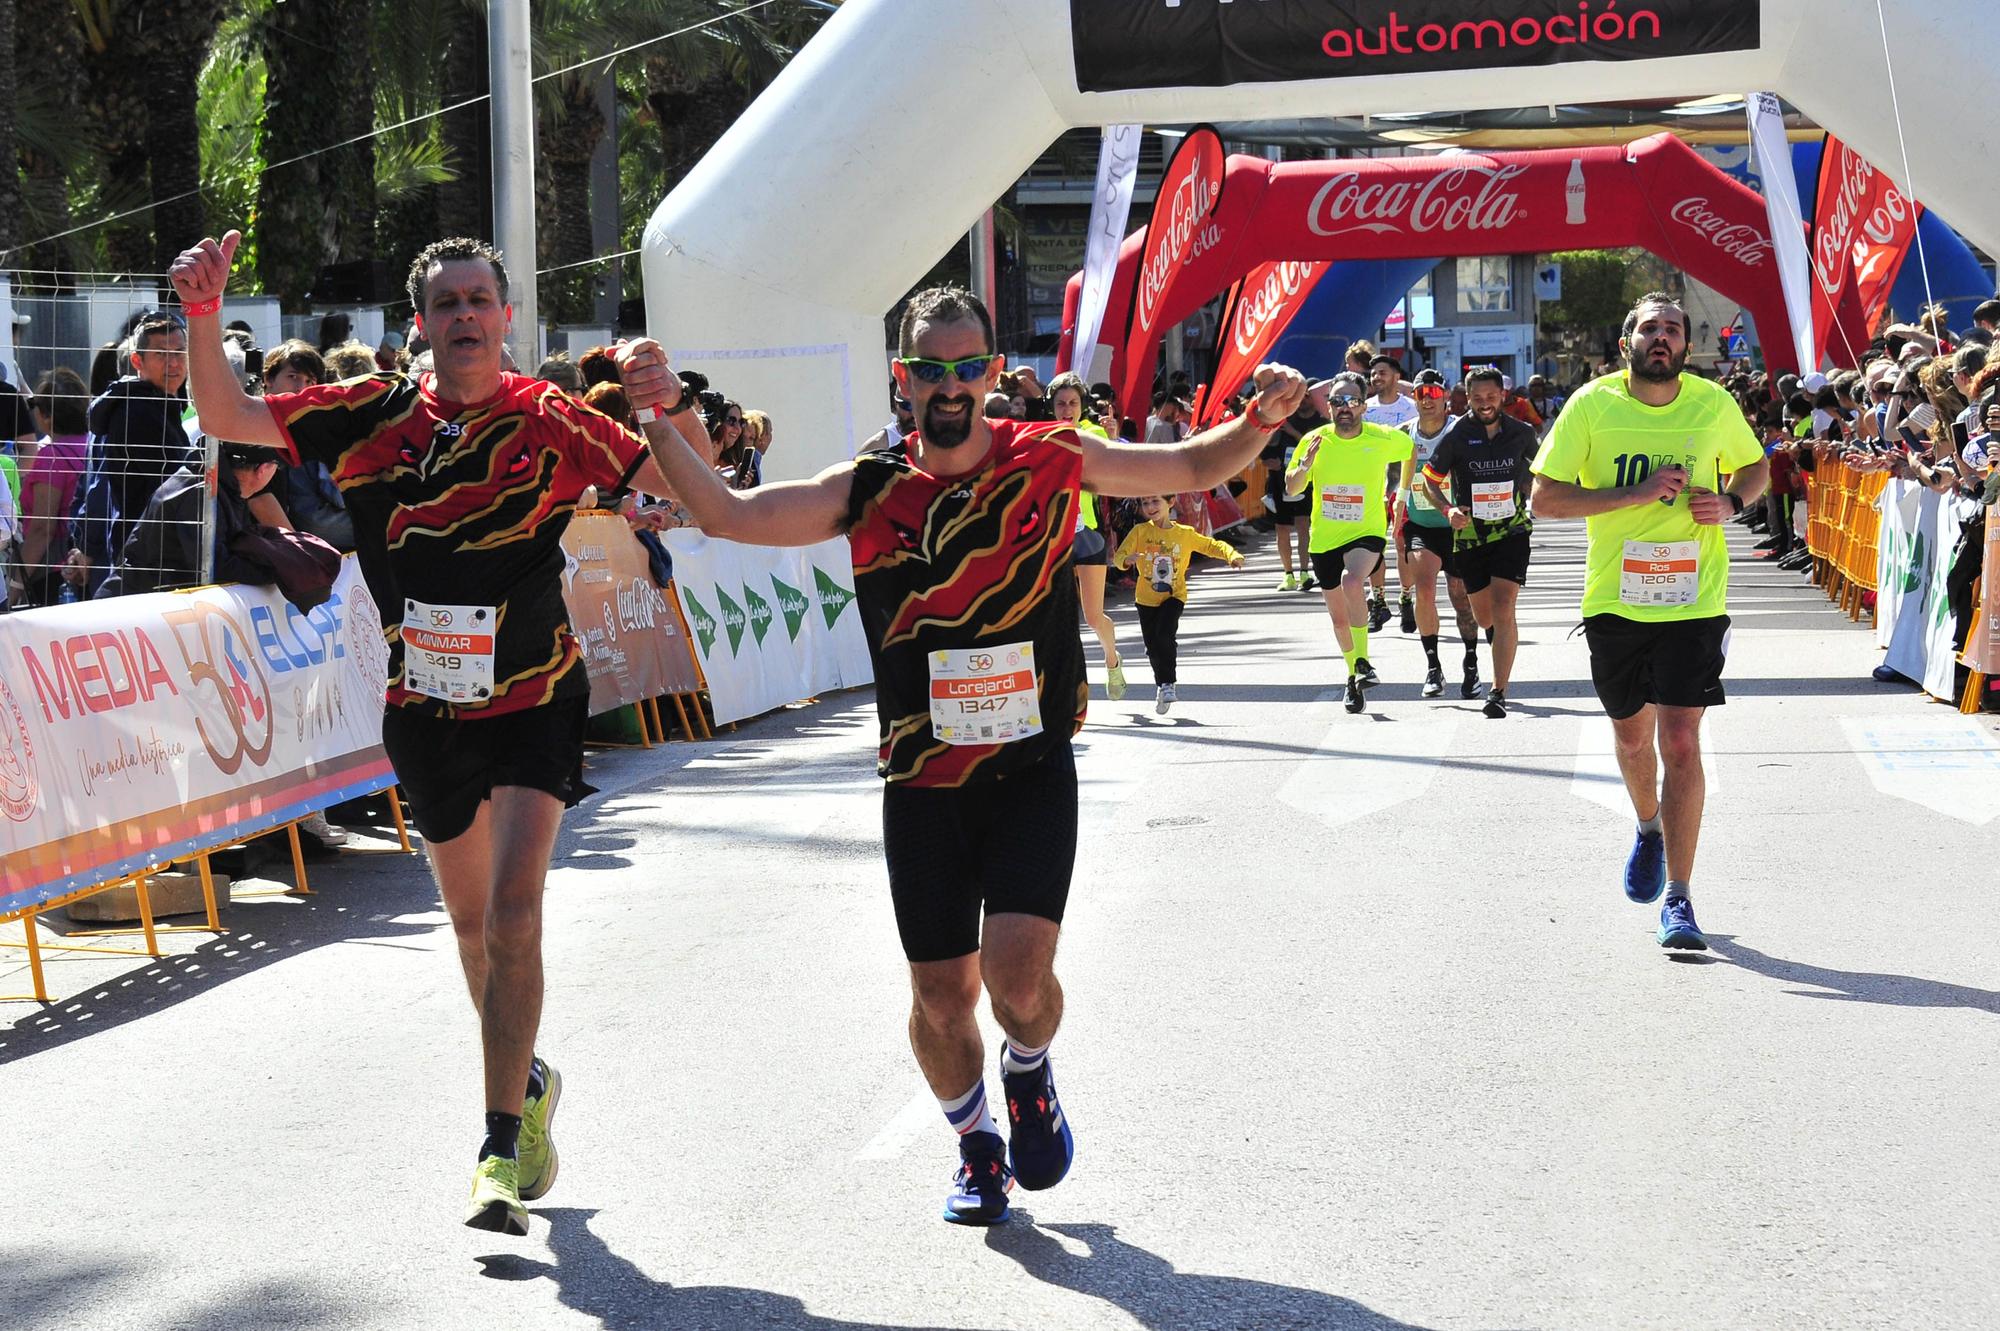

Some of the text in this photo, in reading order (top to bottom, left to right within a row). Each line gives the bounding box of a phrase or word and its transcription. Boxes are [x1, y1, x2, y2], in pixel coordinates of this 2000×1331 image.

[1322, 0, 1660, 57] automoción
[1307, 162, 1532, 236] Coca-Cola
[1671, 197, 1775, 267] Coca-Cola
[1140, 155, 1212, 332] Coca-Cola
[1649, 563, 1670, 572] Ros
[1641, 574, 1677, 585] 1206
[430, 610, 453, 627] 50
[416, 632, 471, 650] MINMAR
[425, 652, 462, 670] 949
[967, 654, 993, 671] 50
[22, 627, 178, 723] MEDIA
[161, 601, 273, 776] 50
[949, 675, 1016, 695] Lorejardi
[959, 697, 1009, 714] 1347
